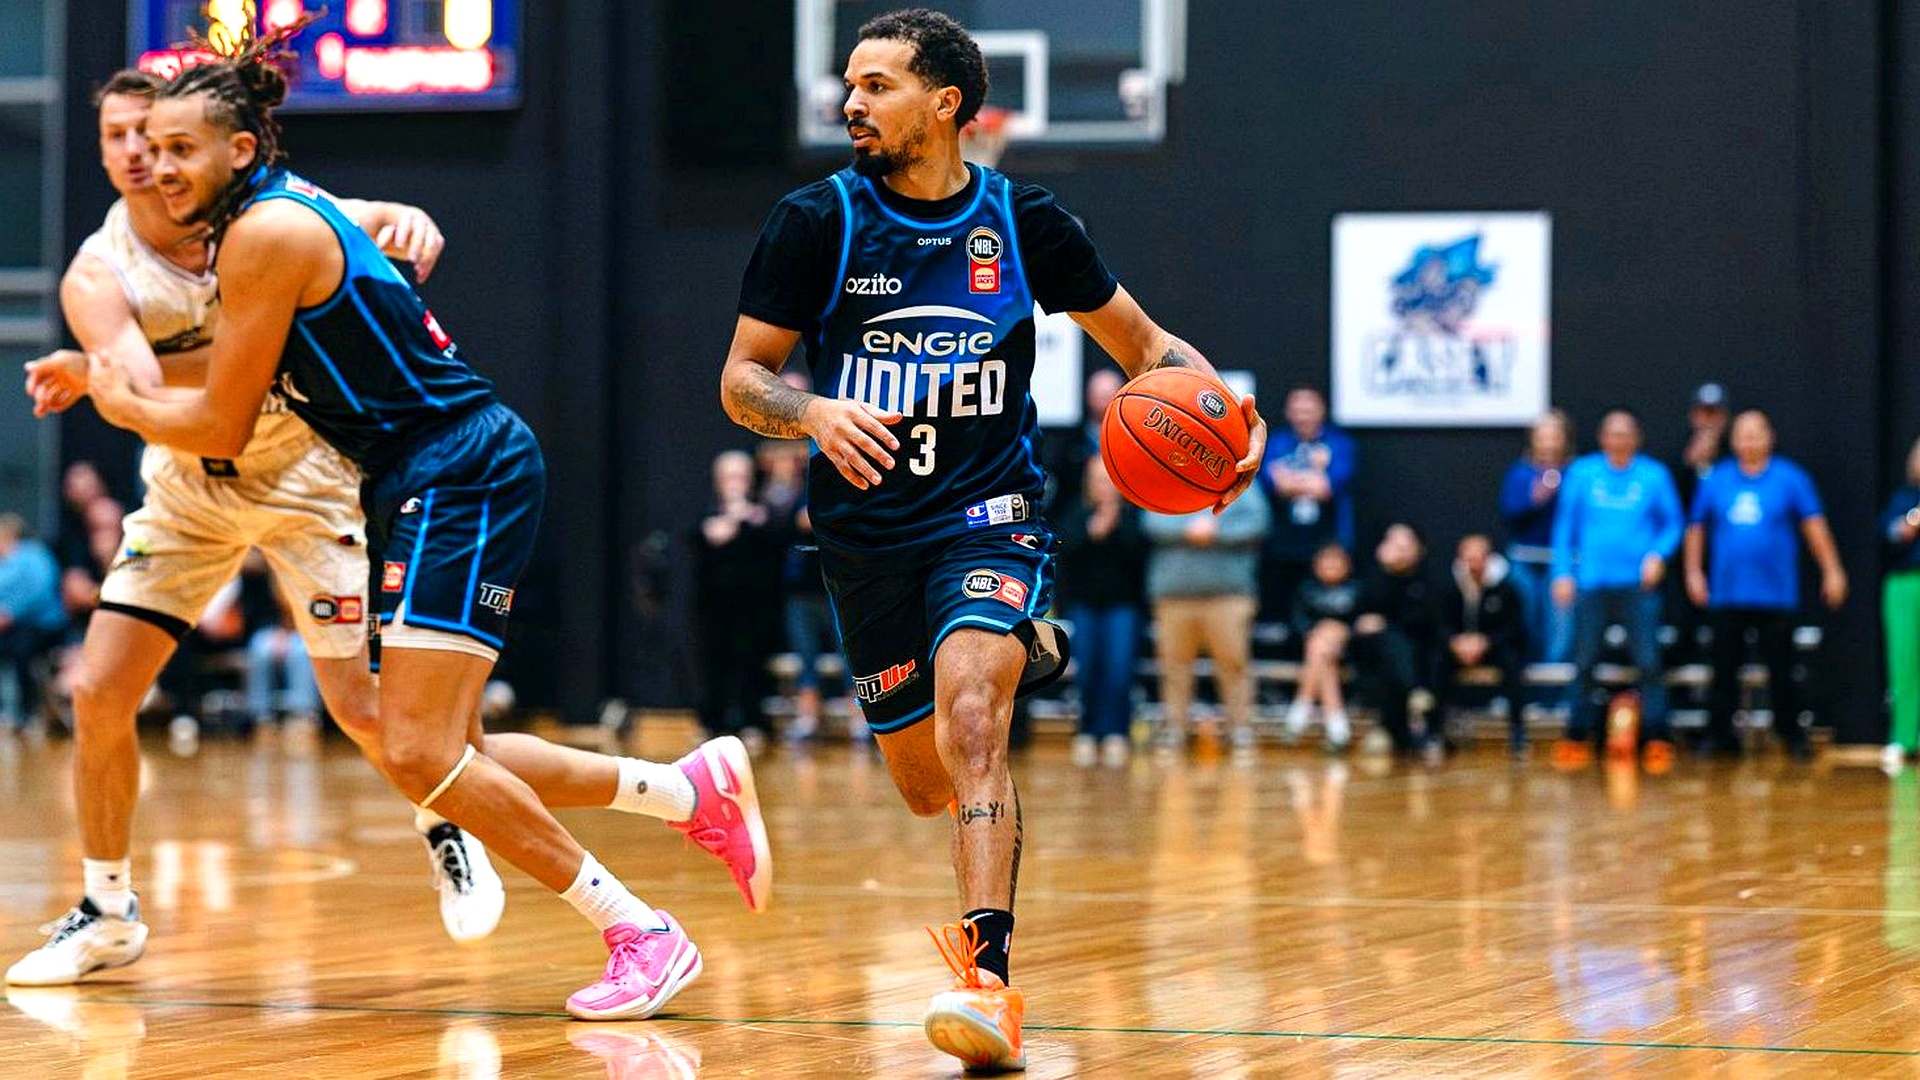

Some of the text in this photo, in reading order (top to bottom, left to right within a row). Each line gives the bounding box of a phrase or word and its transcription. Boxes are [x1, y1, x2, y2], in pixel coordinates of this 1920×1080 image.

[917, 237, 952, 246] OPTUS
[974, 238, 994, 255] NBL
[845, 273, 902, 295] ozito
[837, 353, 1006, 418] UNITED
[909, 424, 937, 476] 3
[1143, 405, 1231, 480] SPALDING
[970, 576, 993, 591] NBL
